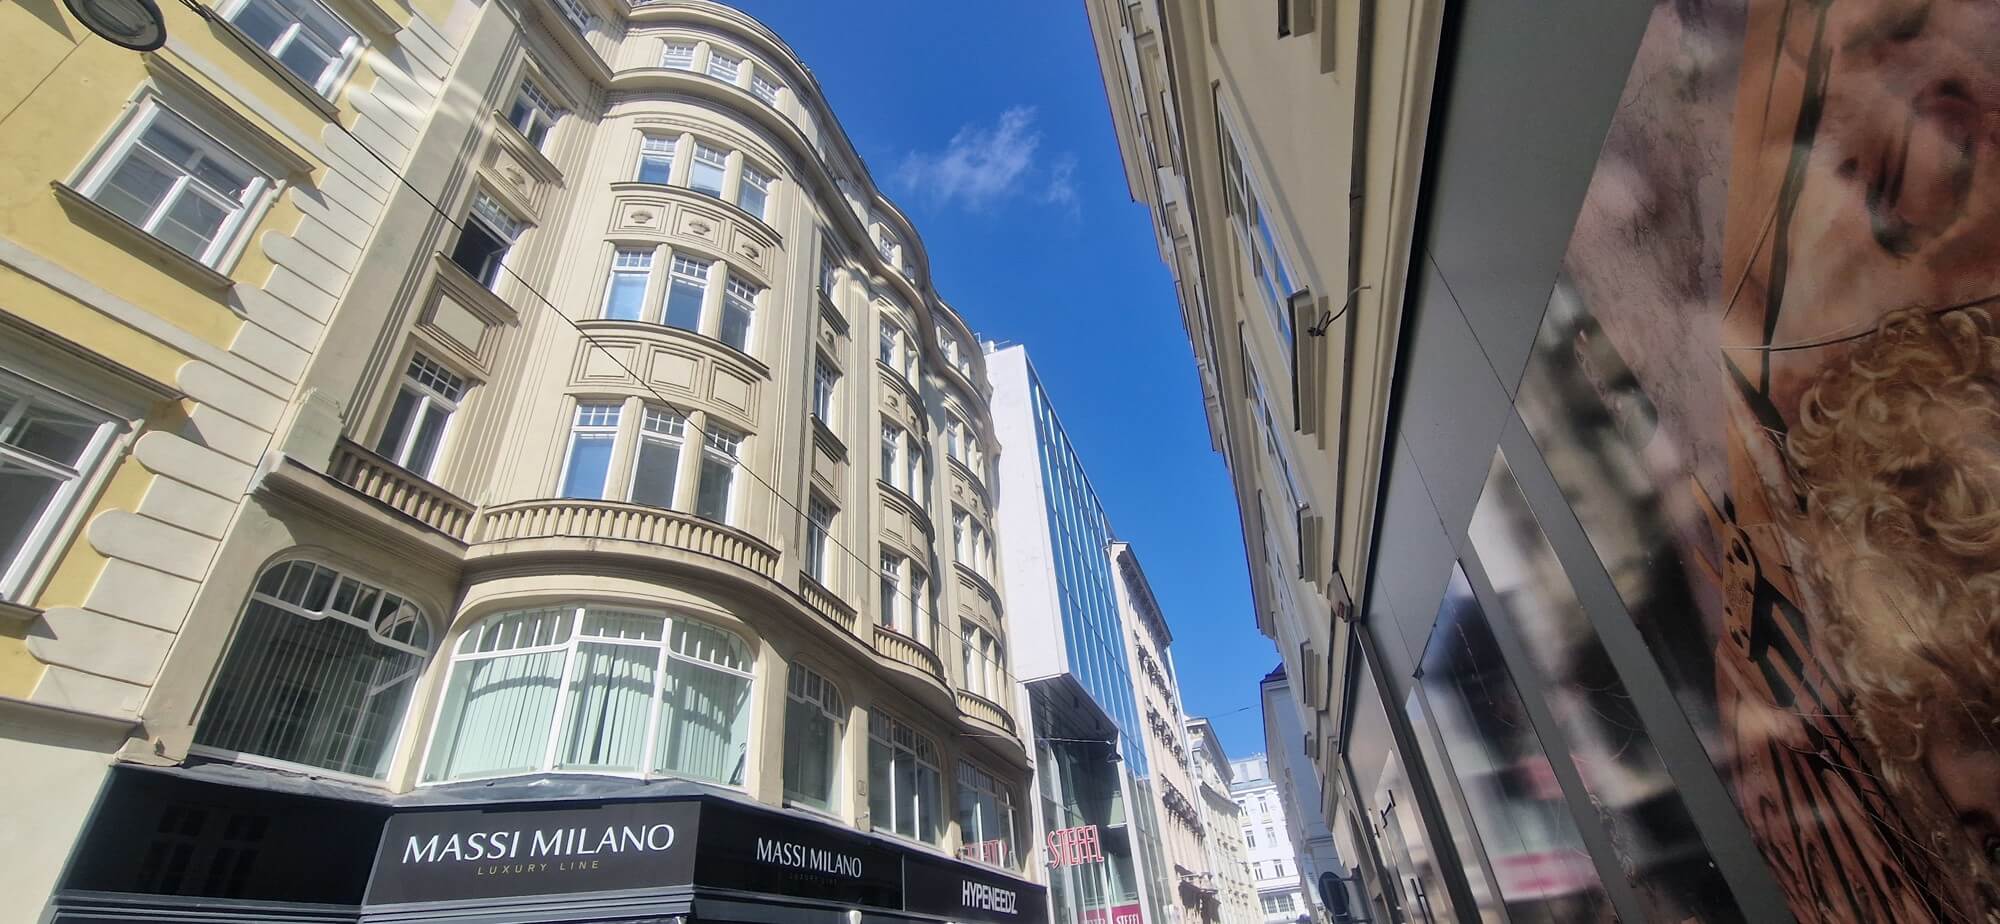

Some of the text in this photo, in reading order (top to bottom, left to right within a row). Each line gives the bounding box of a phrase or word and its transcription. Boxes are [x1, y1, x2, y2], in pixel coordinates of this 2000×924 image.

[402, 823, 675, 864] MASSI MILANO
[756, 837, 862, 878] MASSI MILANO
[477, 860, 600, 876] LUXURY LINE
[962, 880, 1018, 915] HYPENEEDZ
